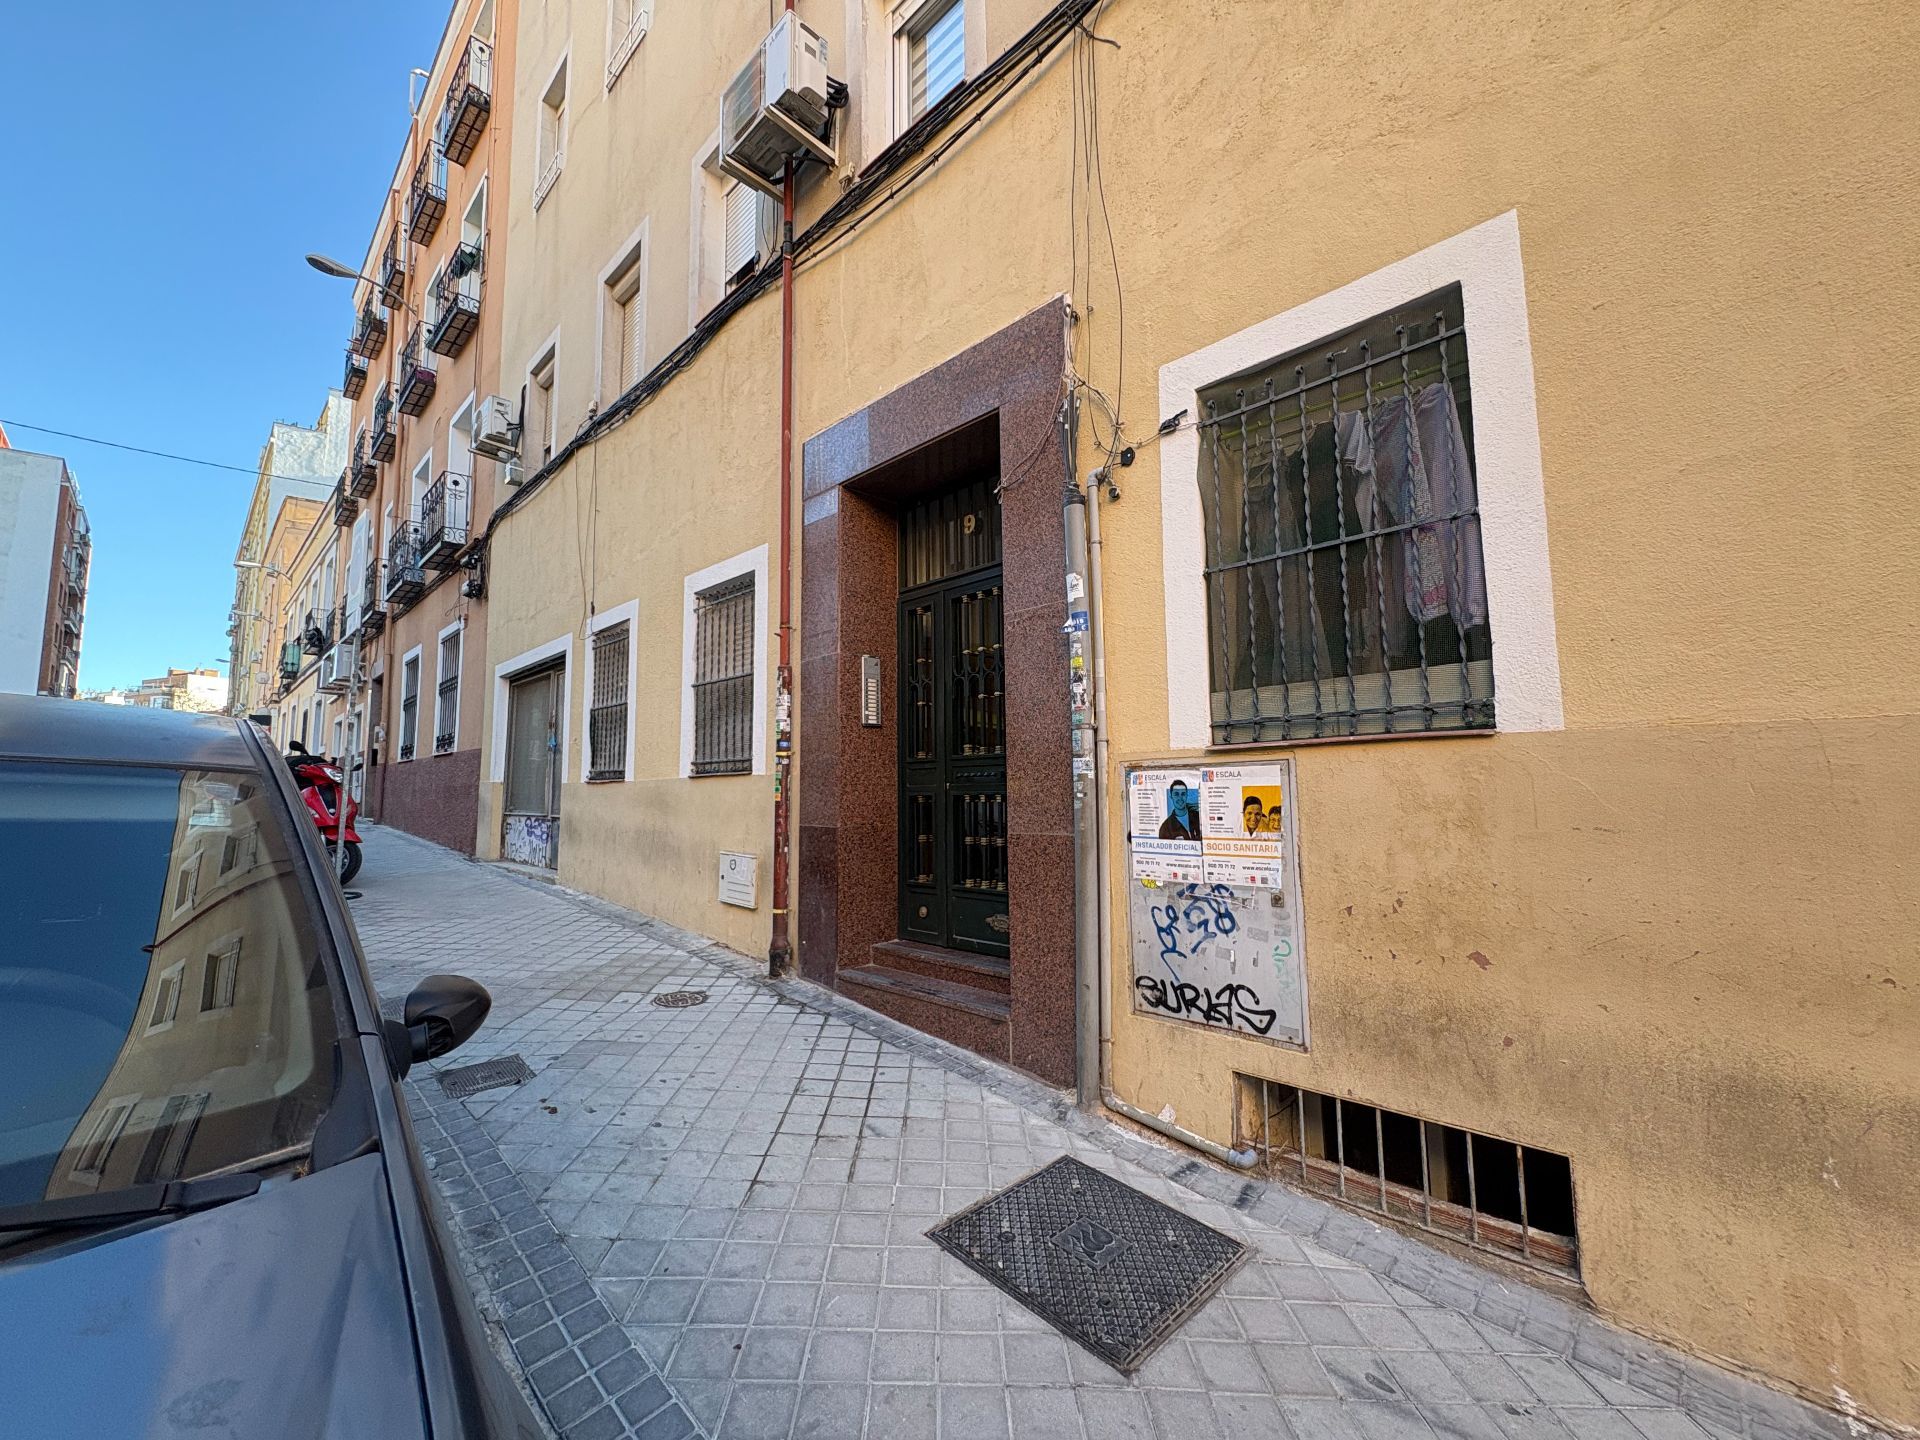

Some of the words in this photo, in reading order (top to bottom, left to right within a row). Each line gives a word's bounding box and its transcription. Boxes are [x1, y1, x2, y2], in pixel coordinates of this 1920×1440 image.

[963, 514, 976, 534] 9
[1215, 770, 1242, 778] ESCALA
[1135, 841, 1173, 850] INSTALADOR
[1173, 843, 1199, 851] OFICIAL
[1206, 842, 1231, 851] SOCIO
[1233, 843, 1279, 853] SANITARIA
[1242, 865, 1280, 873] www.escala.org
